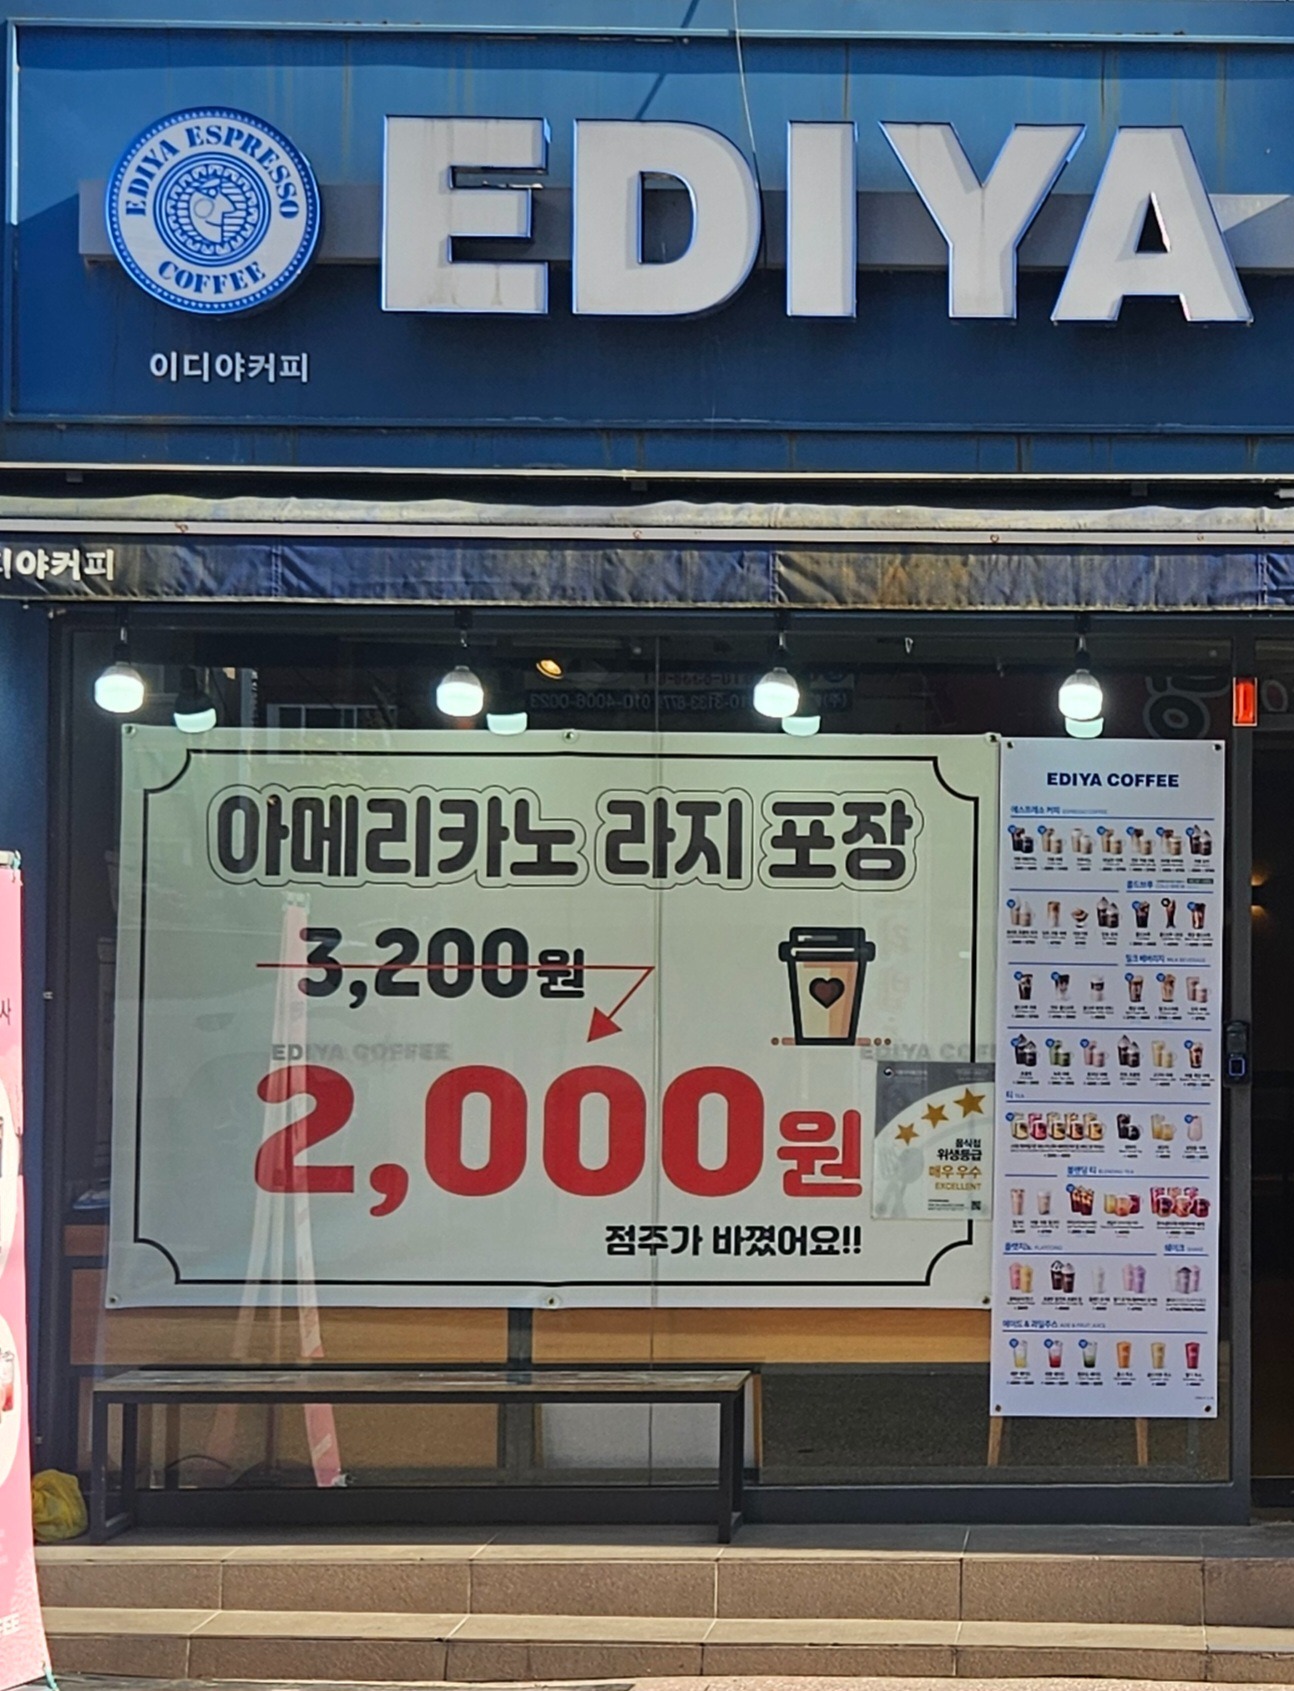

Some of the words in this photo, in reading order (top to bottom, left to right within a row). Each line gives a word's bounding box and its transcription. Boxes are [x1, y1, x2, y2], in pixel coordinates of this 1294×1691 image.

[125, 137, 178, 217] EDIYA
[185, 125, 301, 220] ESPRESSO
[380, 114, 1254, 325] EDIYA
[157, 258, 267, 296] COFFEE
[149, 351, 310, 384] 이디야커피
[1047, 772, 1102, 787] EDIYA
[1107, 773, 1179, 788] COFFEE
[217, 795, 579, 878] 아메리카노
[606, 799, 743, 880] 라지
[768, 800, 914, 881] 포장
[299, 927, 585, 1010] 3,200원
[272, 1044, 344, 1061] EDIYA
[255, 1064, 863, 1217] 2,000원
[937, 1148, 982, 1161] 위생등급
[929, 1165, 954, 1179] 매우
[957, 1165, 982, 1179] 우수
[935, 1182, 982, 1191] EXCELLENT
[605, 1225, 703, 1257] 점주가
[712, 1225, 863, 1257] 바꼈어요!!
